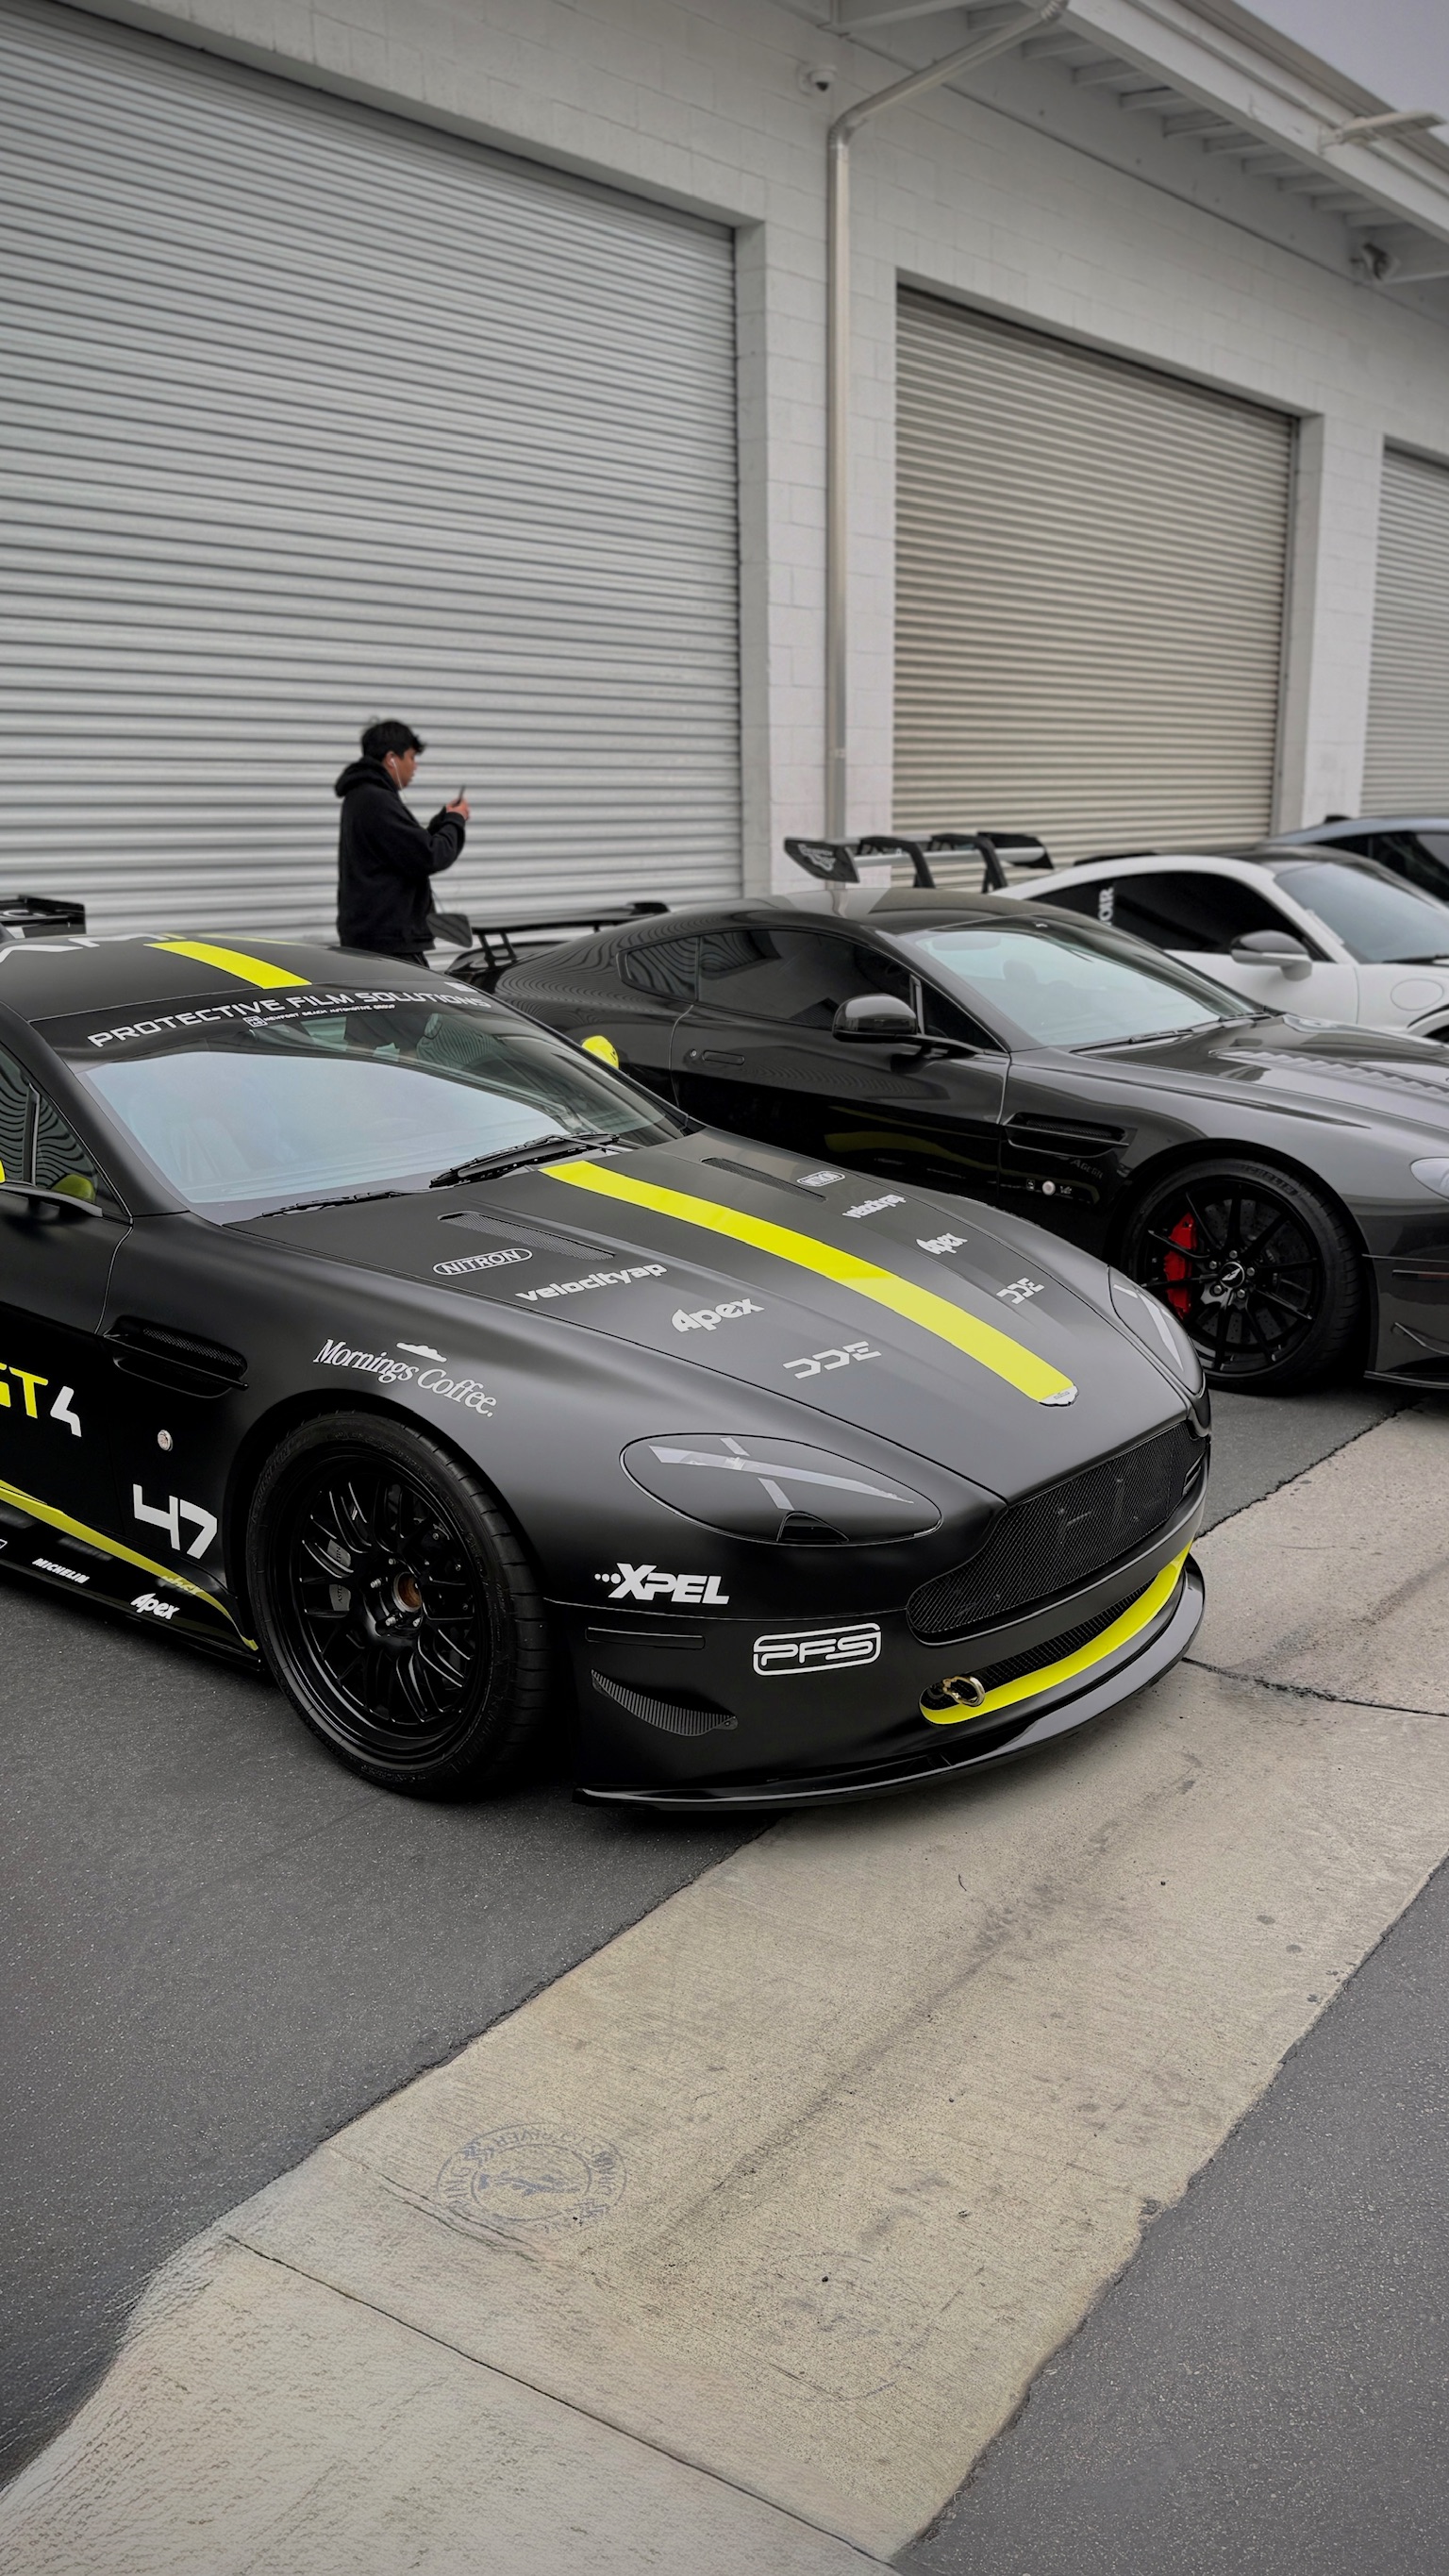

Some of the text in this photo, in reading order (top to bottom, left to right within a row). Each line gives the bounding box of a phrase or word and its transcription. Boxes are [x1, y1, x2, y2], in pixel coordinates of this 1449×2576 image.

[1098, 887, 1114, 926] OIR
[87, 998, 286, 1048] PROTECTIVE
[286, 992, 356, 1010] FILM
[355, 991, 492, 1009] SOLUTIONS
[441, 1249, 522, 1274] NITRON
[672, 1297, 765, 1332] Apex
[312, 1338, 497, 1418] Mornings Coffee.
[132, 1483, 218, 1560] 47
[31, 1557, 91, 1584] MICHELIN
[608, 1563, 730, 1604] XPEL
[131, 1593, 181, 1620] Apex
[755, 1631, 881, 1667] PFS
